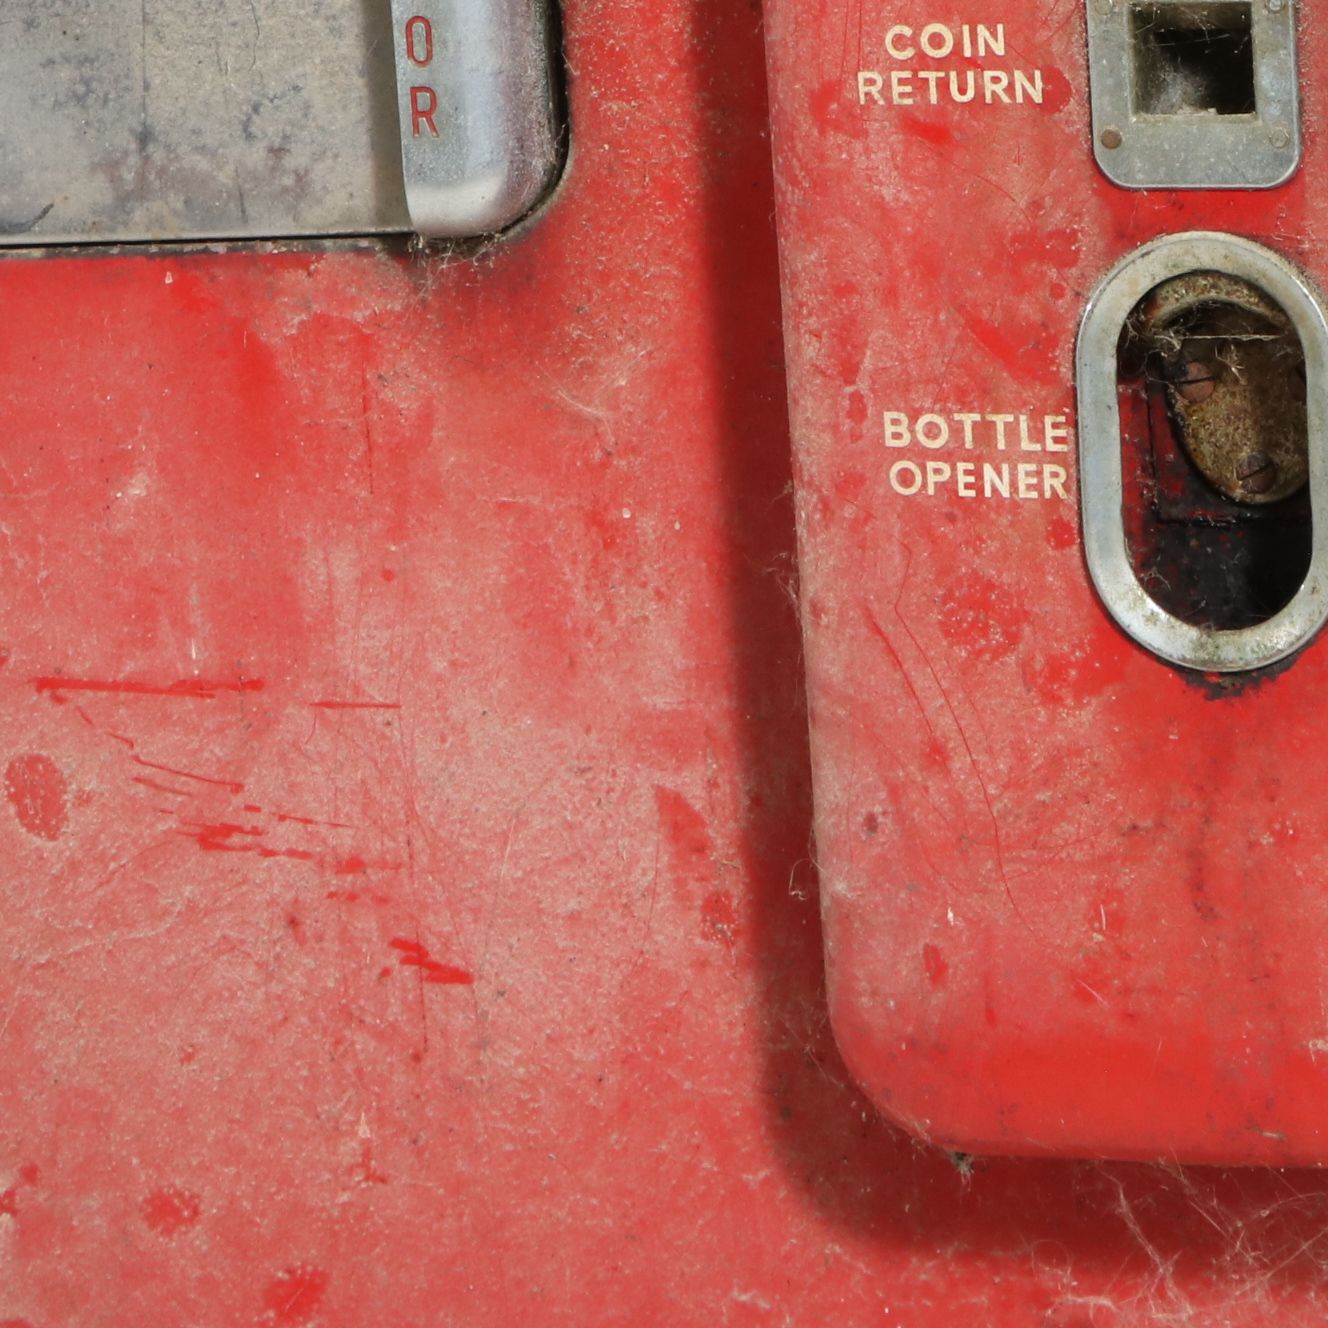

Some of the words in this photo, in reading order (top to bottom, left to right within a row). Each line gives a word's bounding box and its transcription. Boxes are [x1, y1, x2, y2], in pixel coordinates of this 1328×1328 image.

[884, 22, 1006, 60] COIN
[857, 69, 1044, 105] RETURN
[882, 410, 1068, 452] BOTTLE
[888, 460, 1068, 500] OPENER
